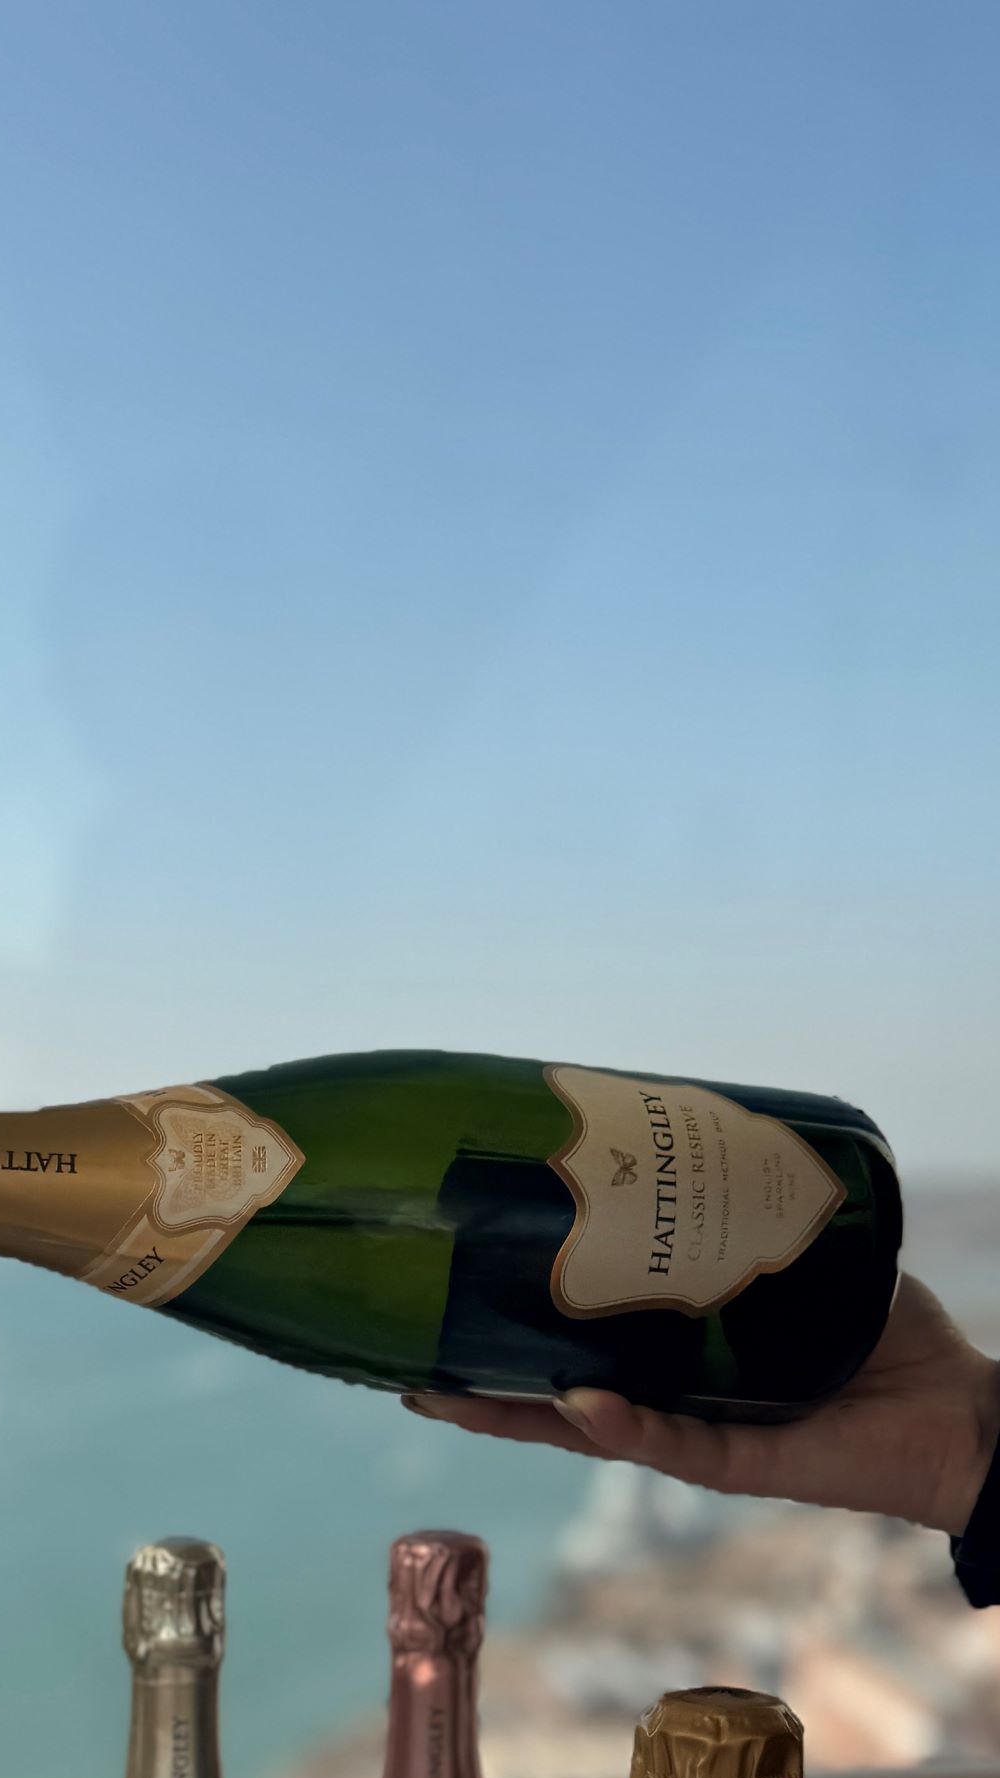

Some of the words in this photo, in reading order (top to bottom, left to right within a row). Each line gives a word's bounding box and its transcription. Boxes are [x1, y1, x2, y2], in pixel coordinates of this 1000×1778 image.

[679, 1104, 706, 1174] RESERVE
[638, 1088, 677, 1276] HATTINGLEY
[686, 1181, 706, 1263] CLASSIC
